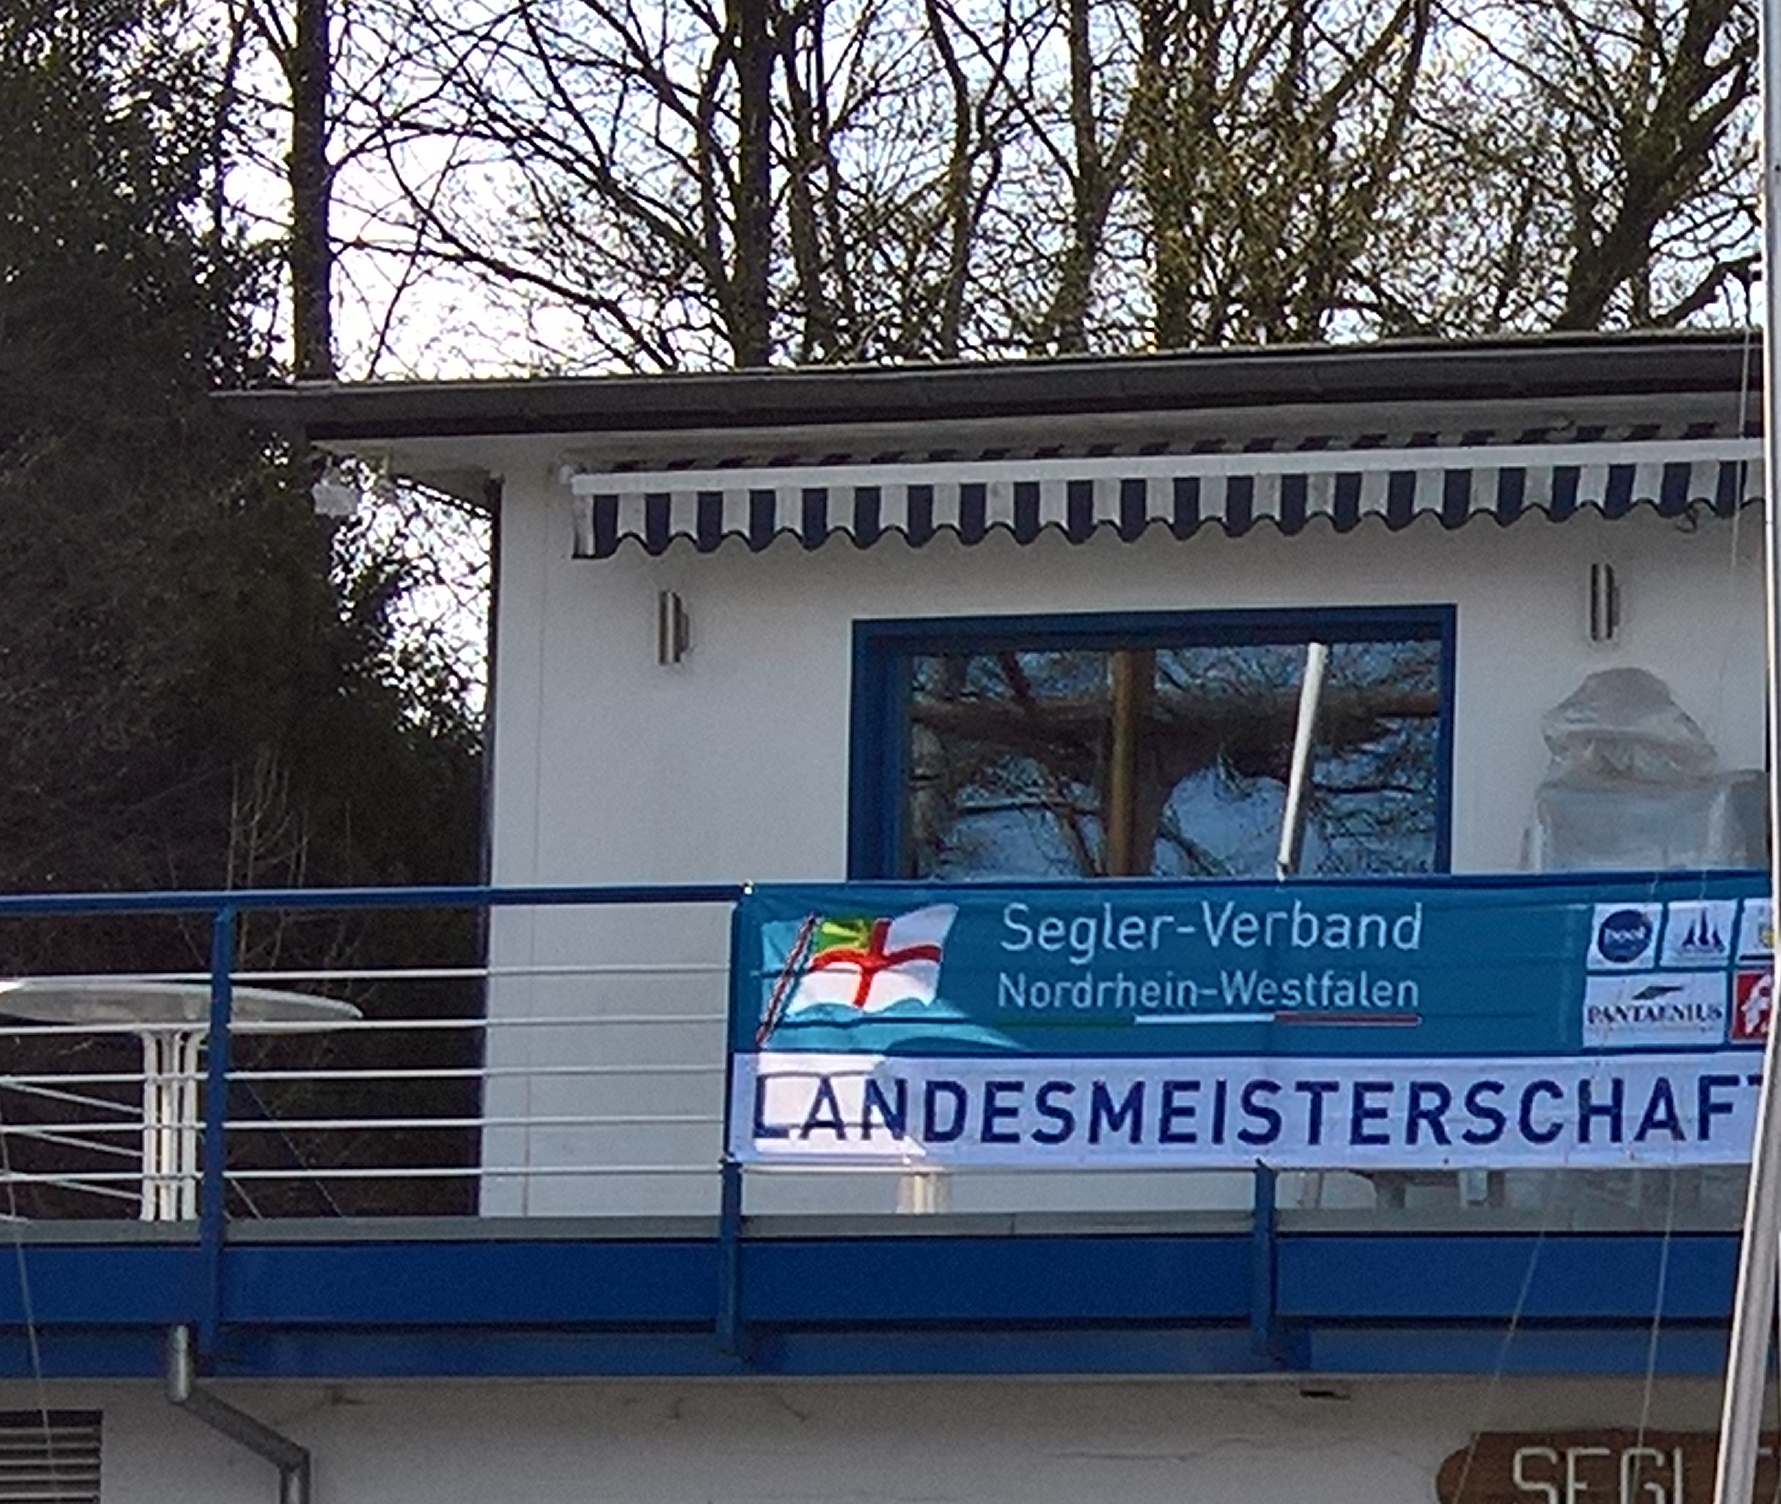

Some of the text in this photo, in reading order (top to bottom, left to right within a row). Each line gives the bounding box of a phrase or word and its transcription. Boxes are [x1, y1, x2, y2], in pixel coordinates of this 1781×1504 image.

[1000, 900, 1422, 965] Segler-Verband
[998, 969, 1420, 1009] Nordrhein-Westfalen
[1586, 1003, 1722, 1025] PANTAENIUS
